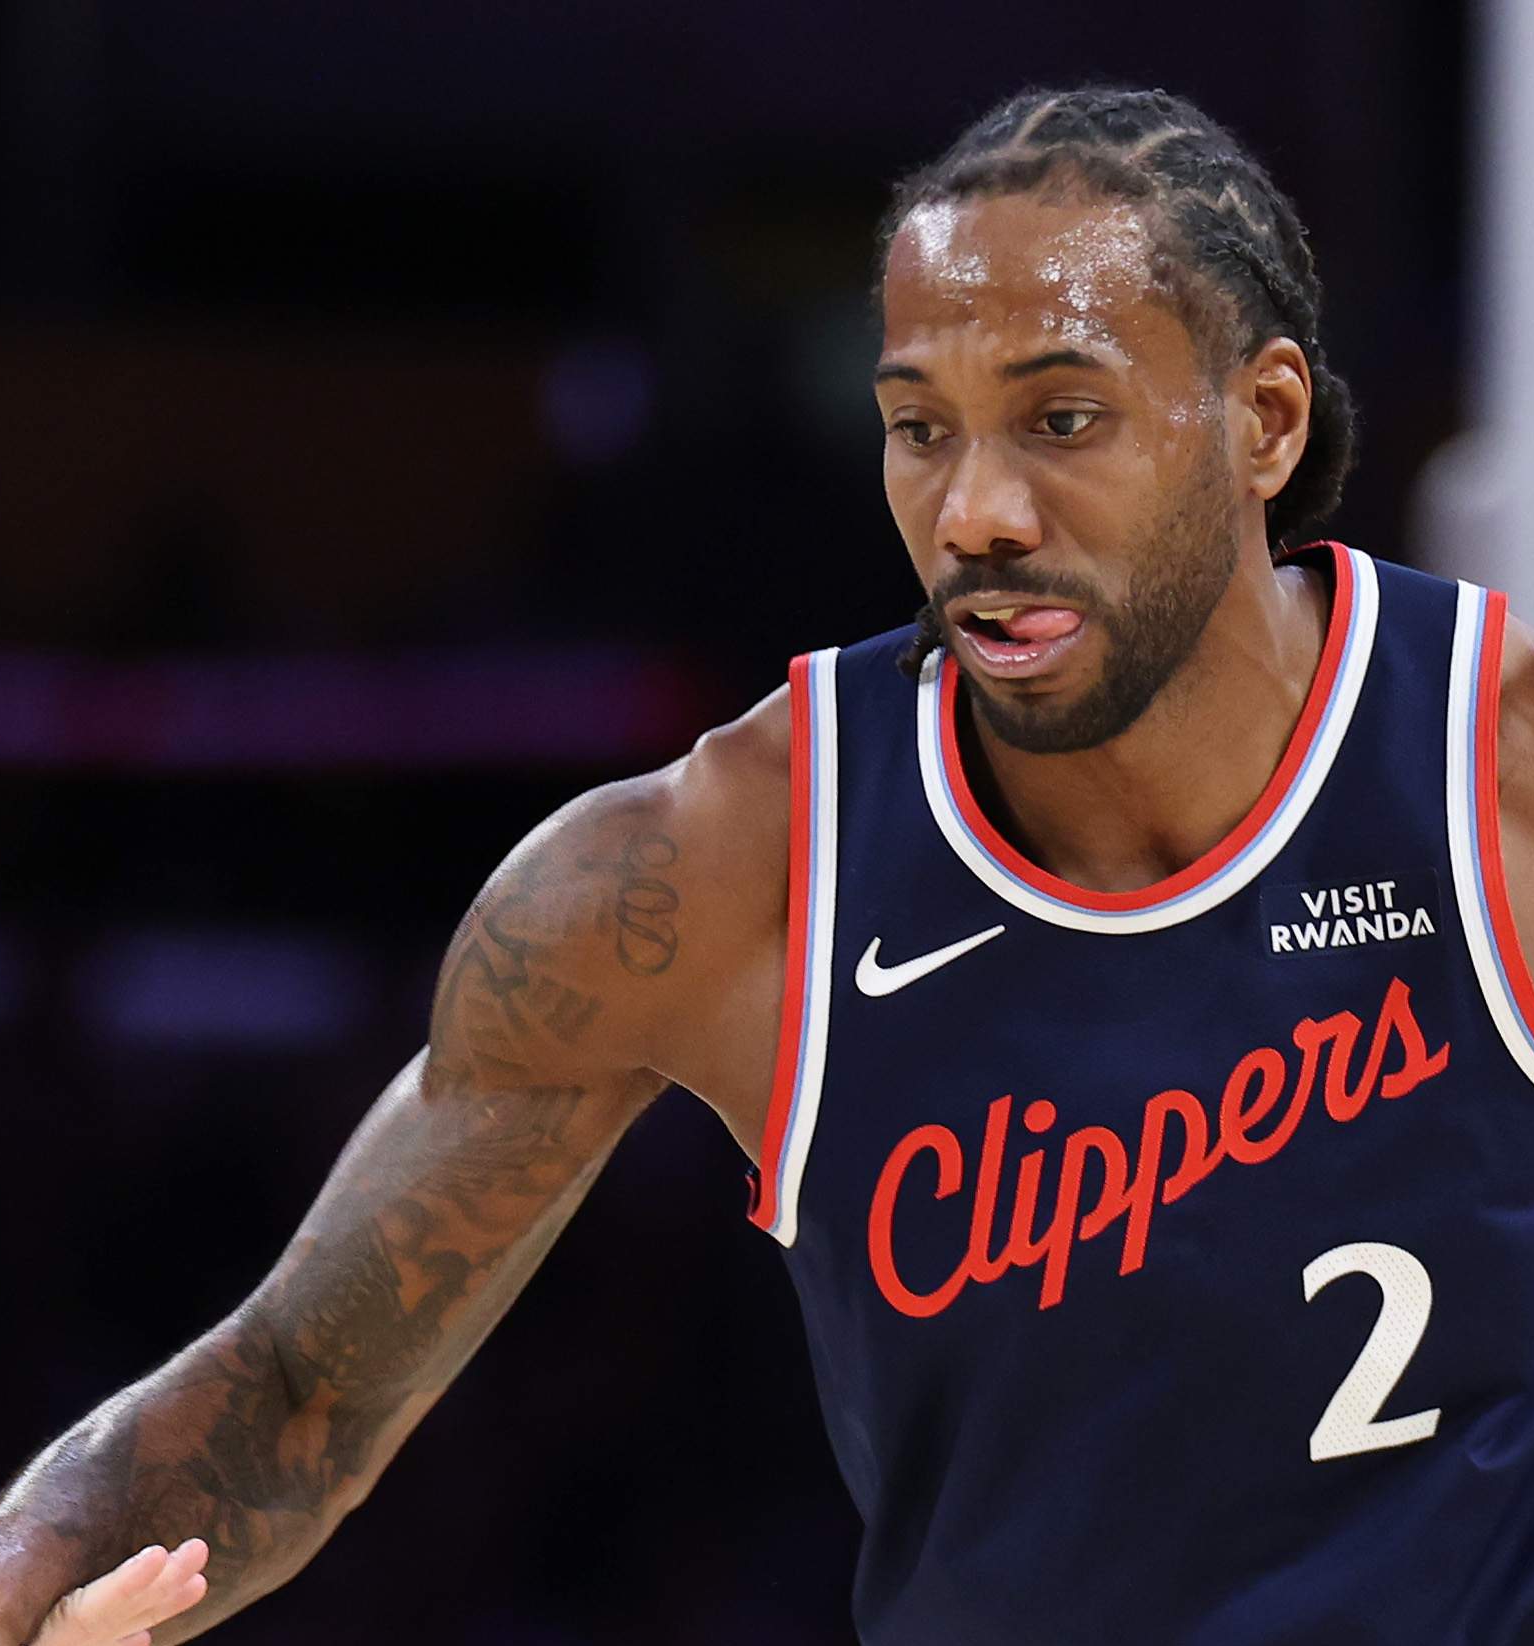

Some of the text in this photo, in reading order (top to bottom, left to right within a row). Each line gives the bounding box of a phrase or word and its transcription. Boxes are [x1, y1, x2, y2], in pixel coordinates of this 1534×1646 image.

[1269, 907, 1436, 953] RWANDA
[1300, 880, 1396, 919] VISIT
[868, 976, 1450, 1318] Clippers
[1302, 1240, 1442, 1463] 2
